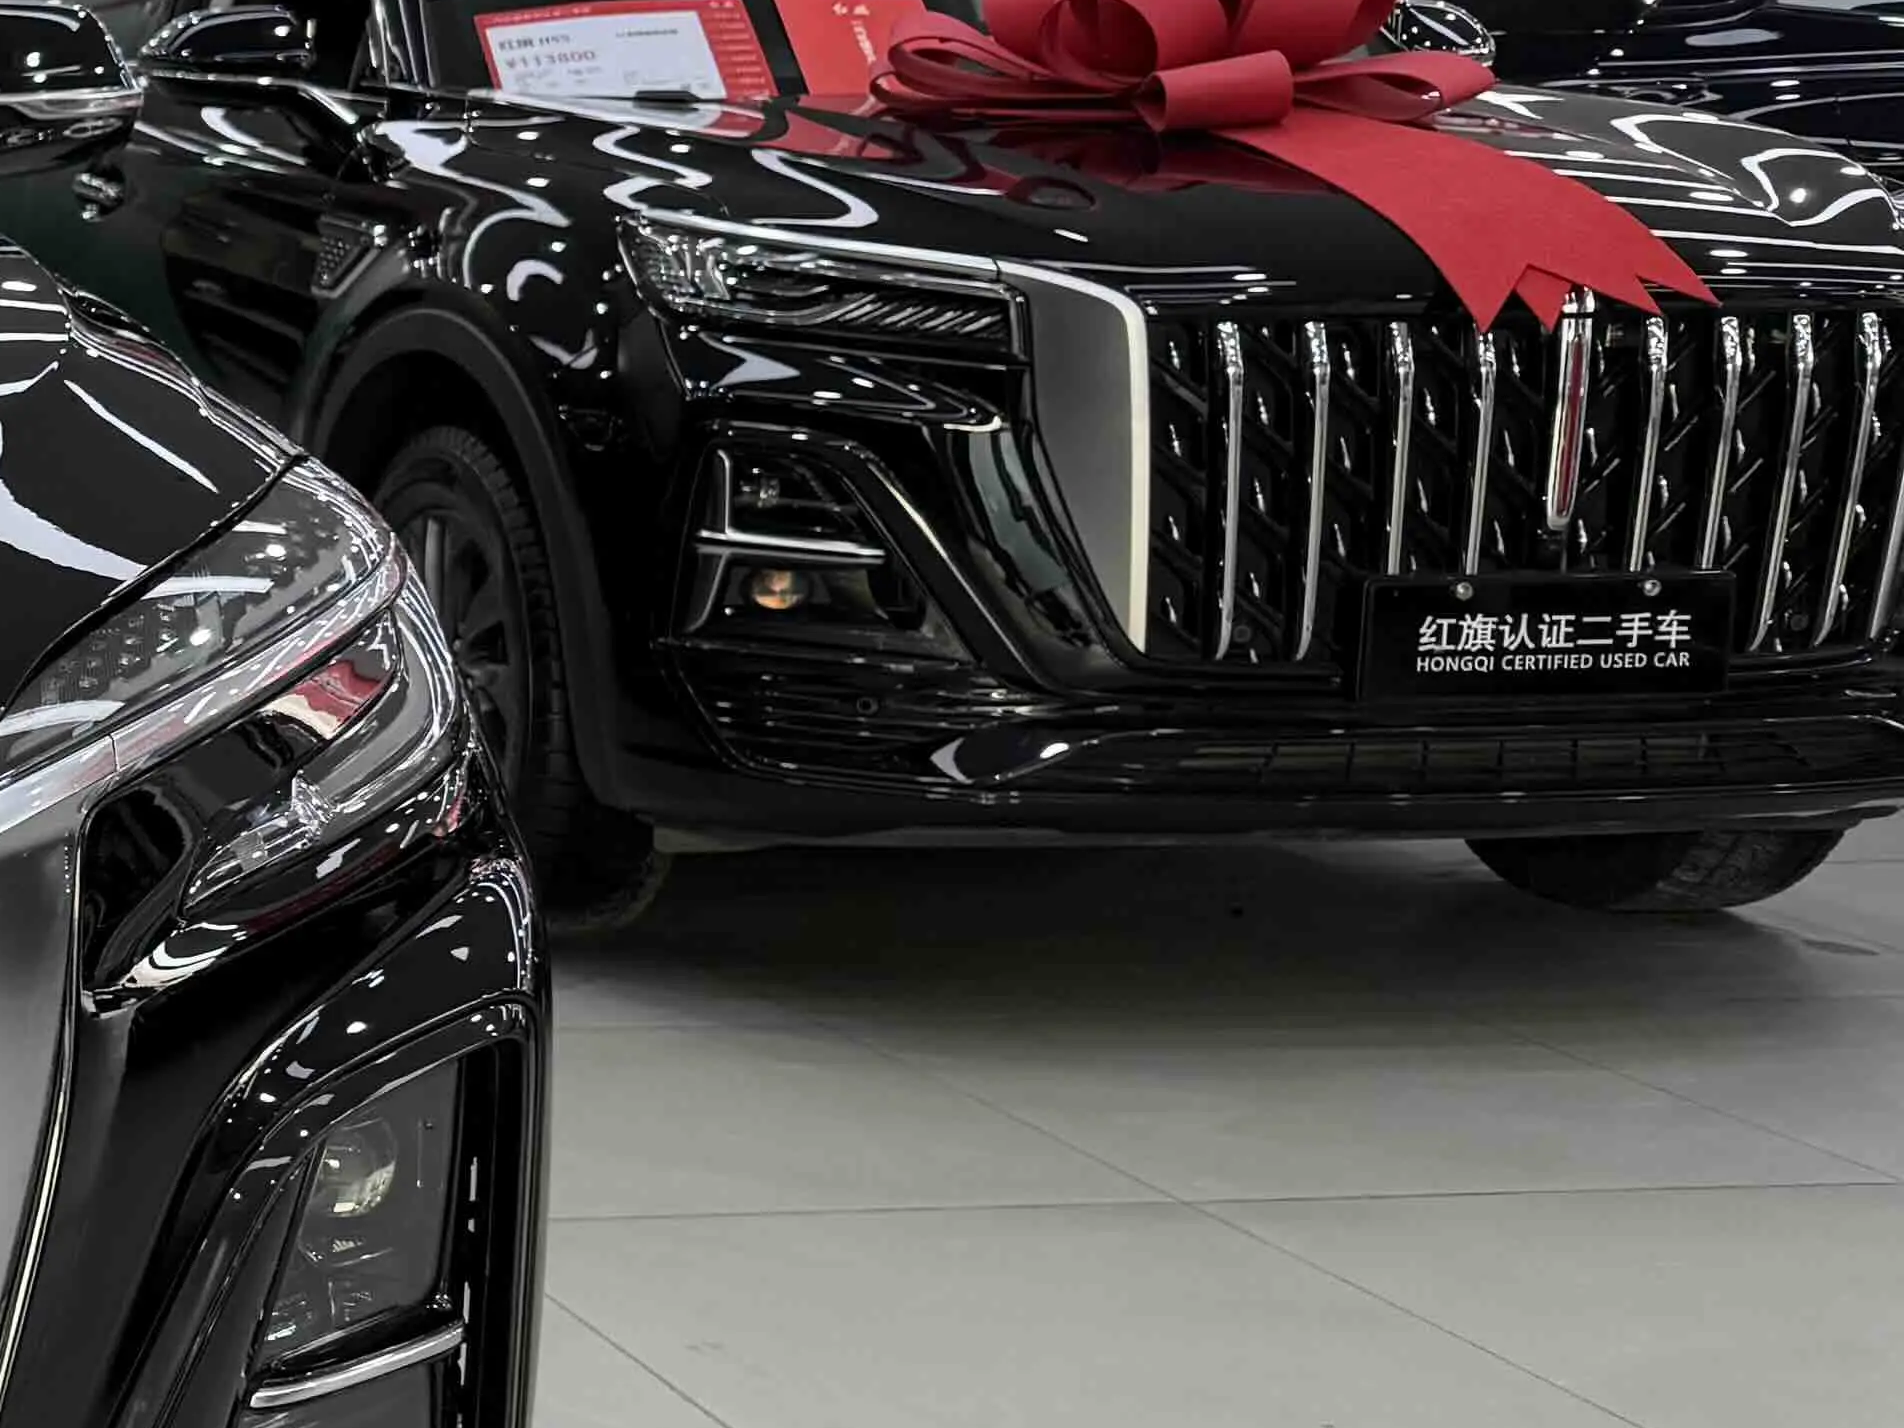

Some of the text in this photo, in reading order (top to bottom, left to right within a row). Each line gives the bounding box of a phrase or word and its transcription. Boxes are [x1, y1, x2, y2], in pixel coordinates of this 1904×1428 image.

[1418, 610, 1691, 653] 红旗认证二手车
[1417, 651, 1691, 673] HONGQI CERTIFIED USED CAR
